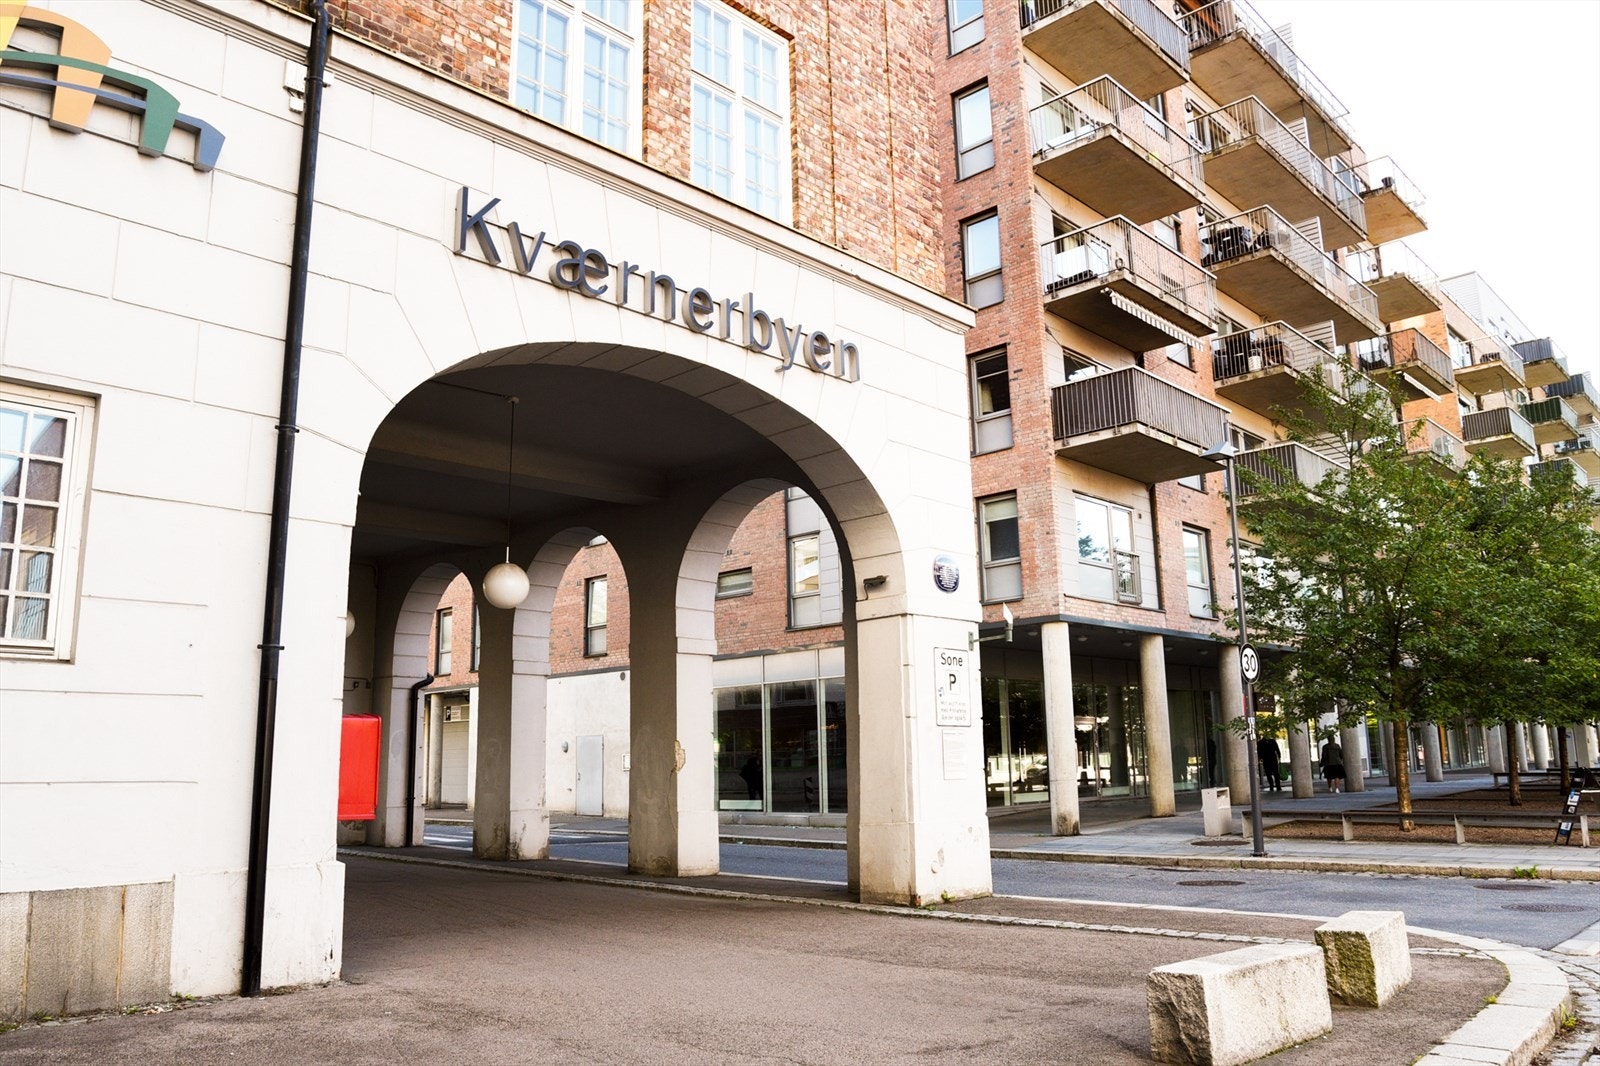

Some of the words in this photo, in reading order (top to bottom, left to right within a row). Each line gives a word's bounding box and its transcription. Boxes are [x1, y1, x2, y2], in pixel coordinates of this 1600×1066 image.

[453, 185, 861, 383] Kværnerbyen
[940, 652, 963, 667] Sone
[1243, 653, 1256, 672] 30
[949, 673, 957, 691] P
